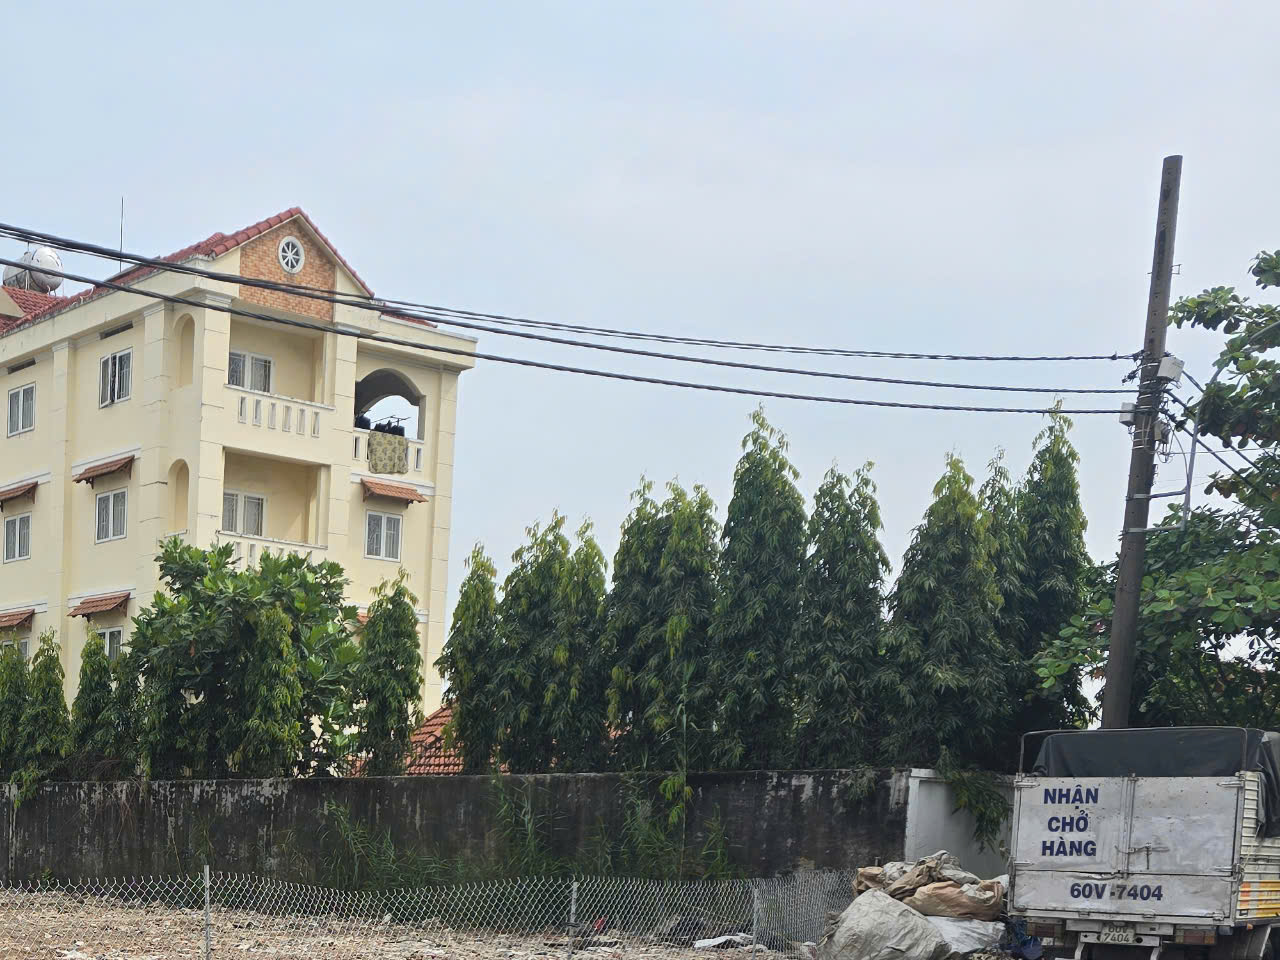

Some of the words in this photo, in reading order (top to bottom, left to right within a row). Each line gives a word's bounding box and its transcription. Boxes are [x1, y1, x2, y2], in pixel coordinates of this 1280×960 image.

[1043, 784, 1099, 810] NHẬN
[1047, 809, 1089, 833] CHỞ
[1041, 836, 1097, 857] HÀNG
[1103, 932, 1130, 943] 7404
